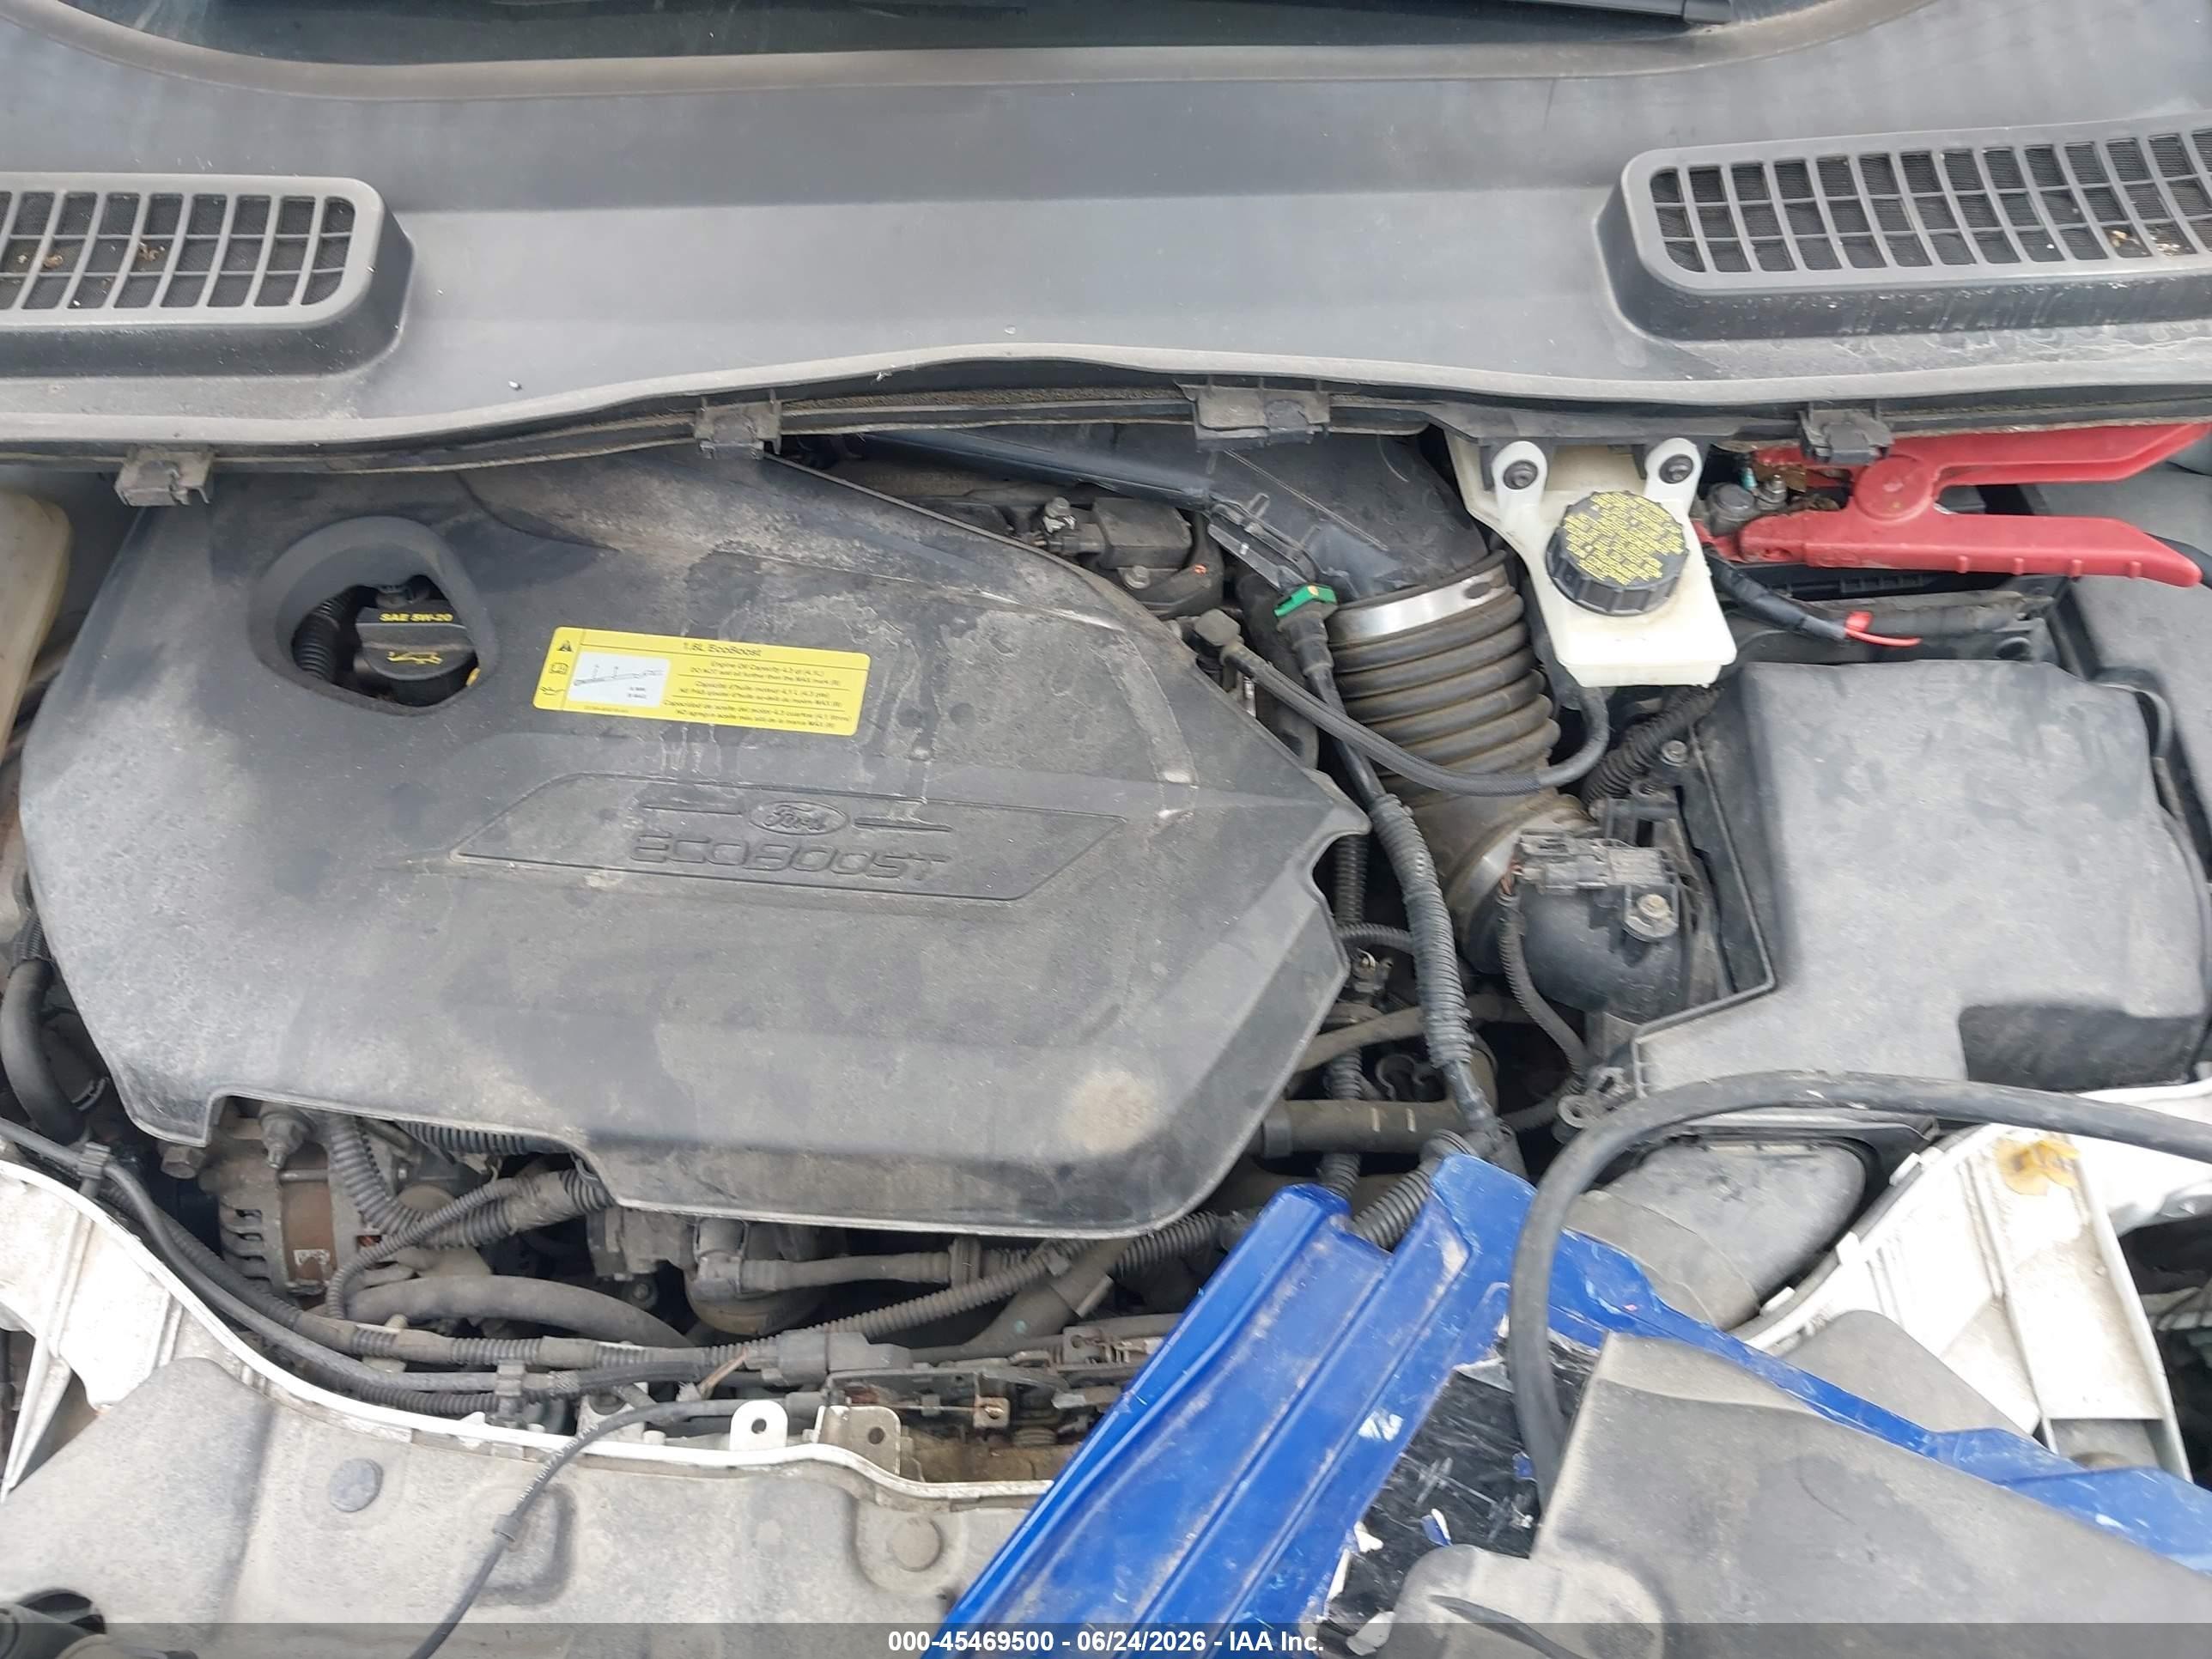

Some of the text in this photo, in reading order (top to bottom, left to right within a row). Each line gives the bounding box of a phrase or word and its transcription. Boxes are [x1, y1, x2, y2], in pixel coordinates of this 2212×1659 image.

[380, 612, 454, 622] SAE 5W-20
[708, 643, 762, 656] EcoBoost
[629, 831, 953, 881] ECOBOOST
